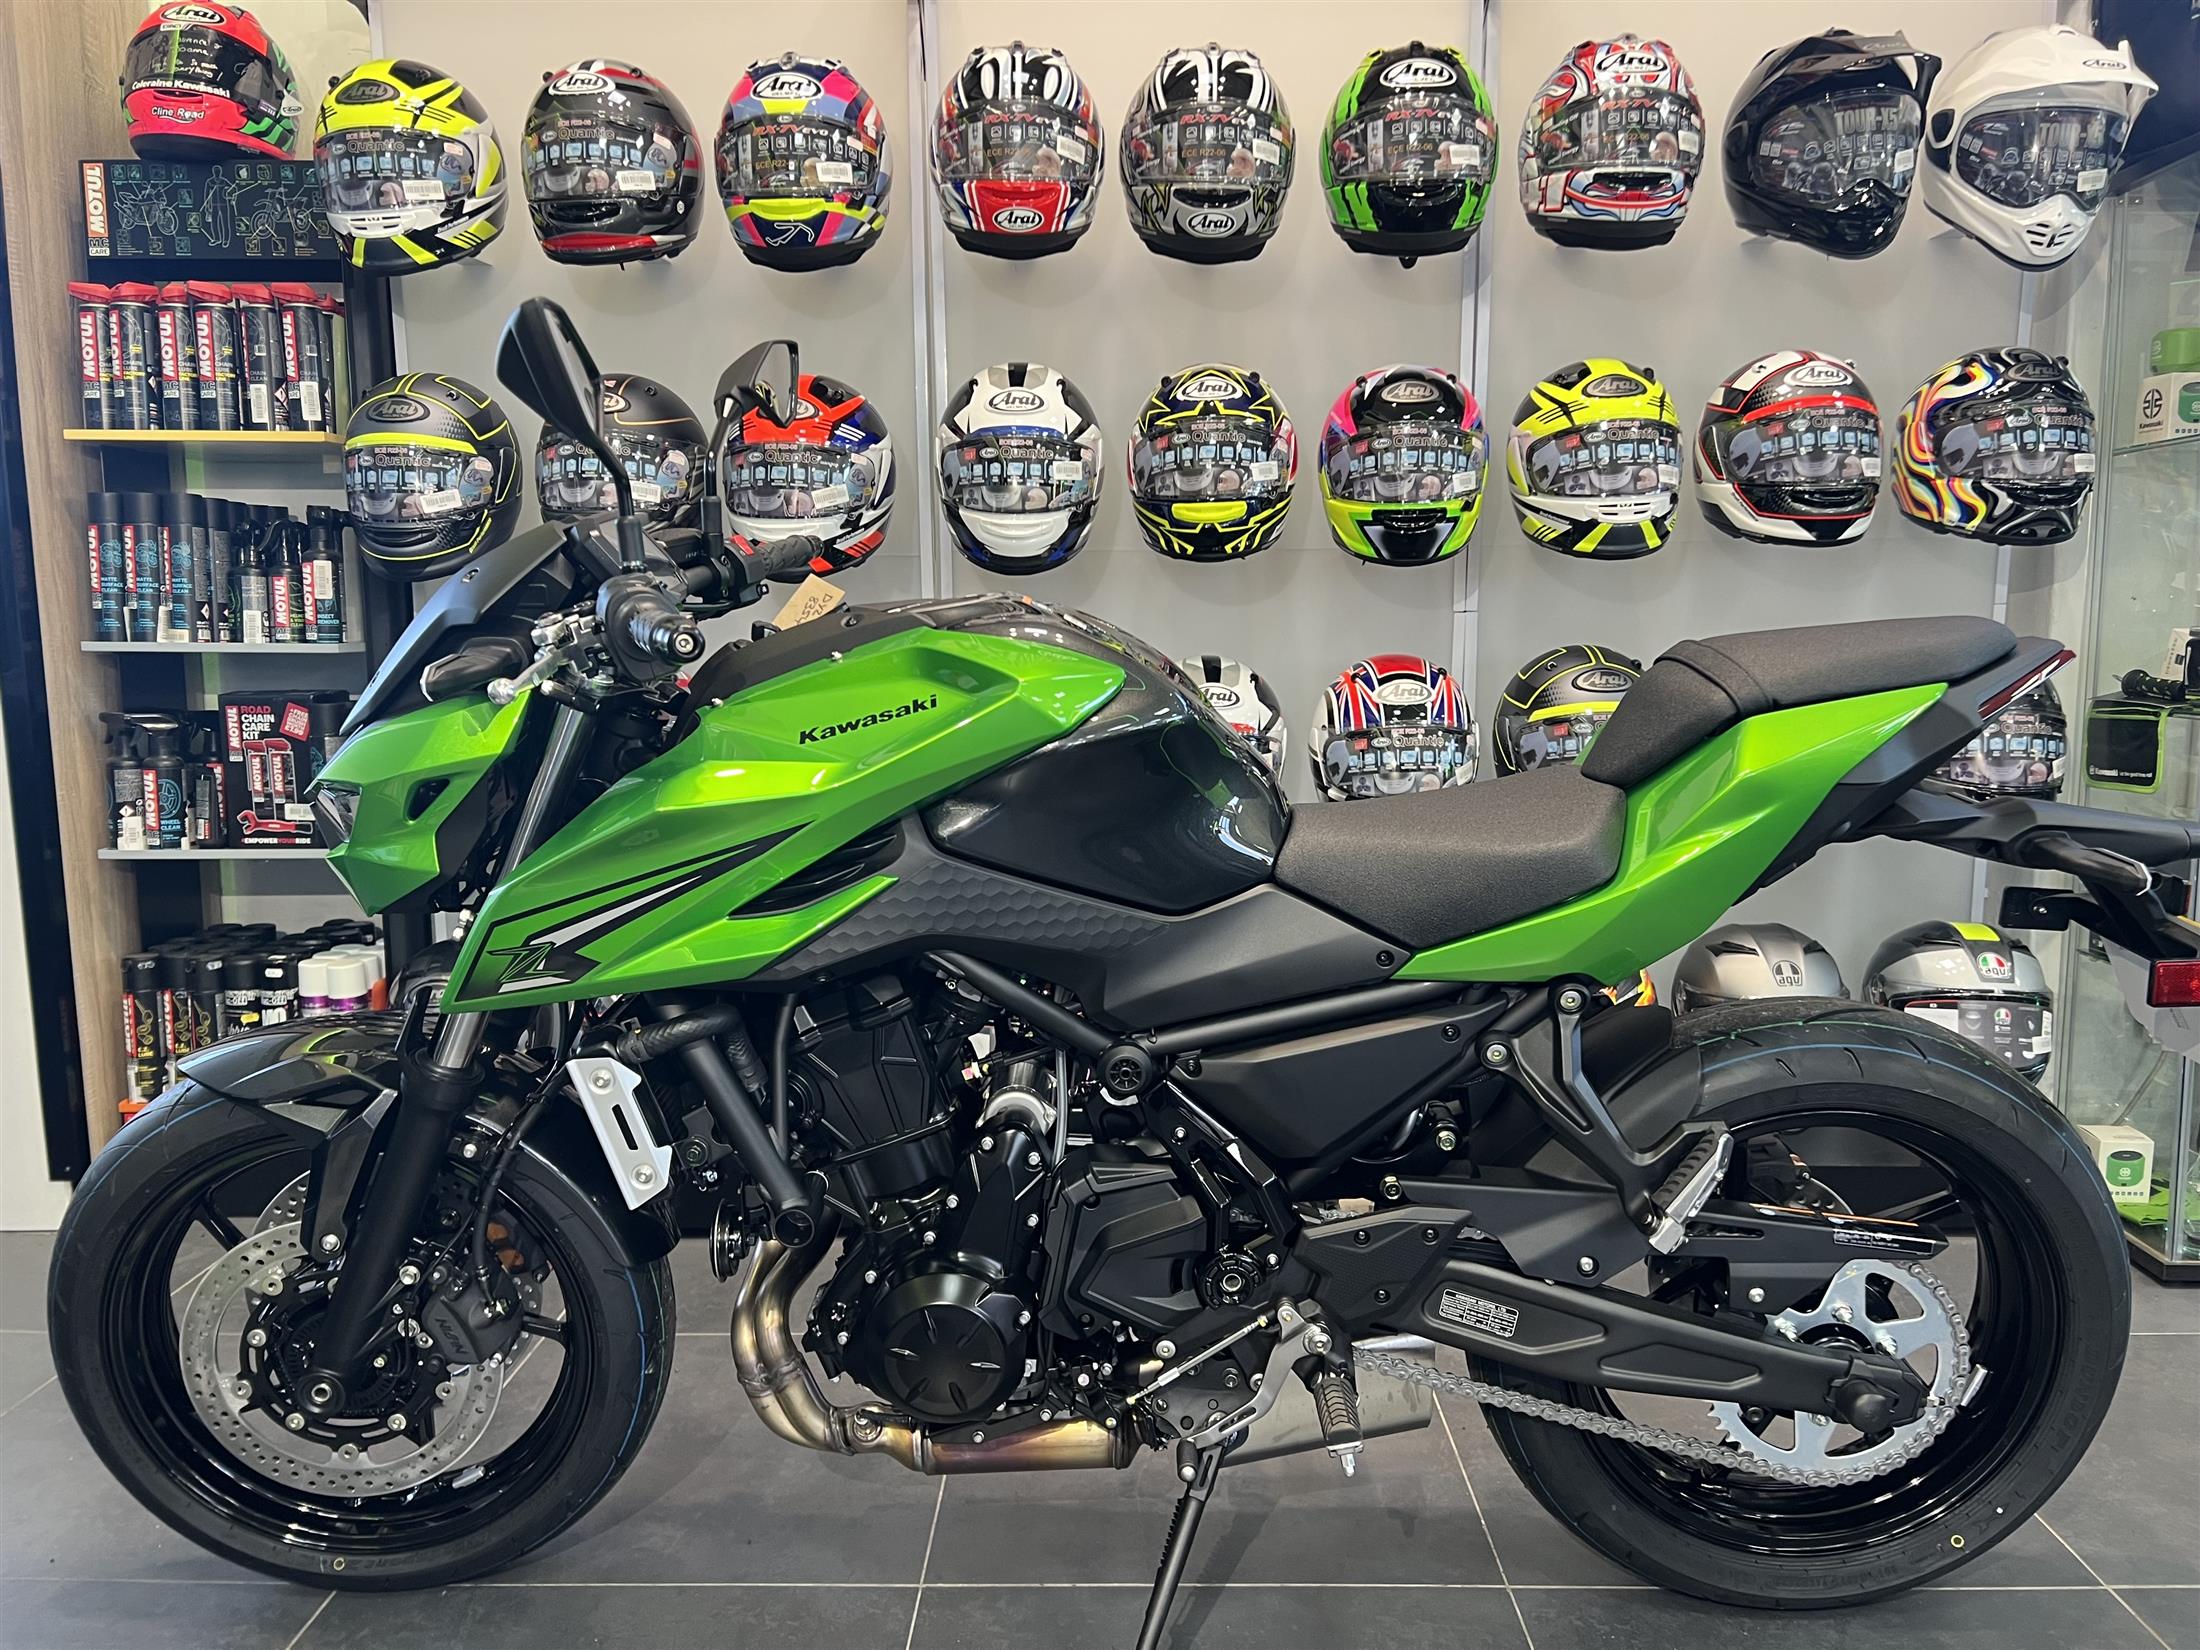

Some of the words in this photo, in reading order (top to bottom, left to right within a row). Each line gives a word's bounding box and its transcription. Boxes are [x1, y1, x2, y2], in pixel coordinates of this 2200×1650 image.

[1607, 53, 1660, 69] Arai
[1392, 60, 1446, 79] Arai
[554, 73, 600, 88] Arai
[132, 79, 173, 90] Coleraine
[174, 79, 231, 98] Kawasaki
[343, 82, 388, 98] Arai
[151, 106, 174, 117] Cline
[177, 109, 205, 120] Road
[984, 113, 1036, 124] RX-7V
[1180, 113, 1234, 125] RX-7V
[1834, 107, 1901, 134] TOUR-X5
[558, 127, 615, 140] Quantic
[752, 124, 801, 137] RX-7V
[347, 140, 405, 152] Quantic
[86, 165, 106, 234] MOTUL
[997, 211, 1038, 226] Arai
[1193, 214, 1231, 230] Arai
[89, 237, 110, 248] MC
[90, 248, 109, 256] CARE
[80, 313, 96, 378] MOTUL
[159, 313, 175, 379] MOTUL
[196, 313, 213, 378] MOTUL
[282, 313, 296, 379] MOTUL
[1801, 366, 1842, 380] Arai
[2020, 362, 2060, 377] Arai
[1188, 380, 1230, 395] Arai
[1392, 382, 1431, 397] Arai
[1598, 377, 1638, 391] Arai
[994, 391, 1038, 407] Arai
[375, 399, 418, 415] Arai
[1811, 416, 1865, 428] Quantic
[1192, 430, 1247, 442] Quantic
[1393, 435, 1448, 448] Quantic
[1608, 428, 1660, 441] Quantic
[765, 450, 819, 464] Quantic
[1000, 446, 1054, 459] Quantic
[374, 454, 432, 467] Quantic
[87, 528, 100, 590] MOTUL
[303, 565, 315, 622] MOTUL
[274, 578, 288, 626] MOTUL
[1587, 671, 1627, 686] Arai
[1202, 687, 1234, 704] Arai
[1385, 684, 1425, 698] Arai
[240, 705, 272, 714] ROAD
[241, 714, 275, 723] CHAIN
[799, 694, 938, 745] Kawasaki
[226, 707, 241, 749] MOTUL
[242, 723, 271, 732] CARE
[243, 731, 260, 740] KIT
[1393, 735, 1445, 747] Quantic
[272, 755, 283, 792] MOTUL
[144, 772, 158, 828] MOTUL
